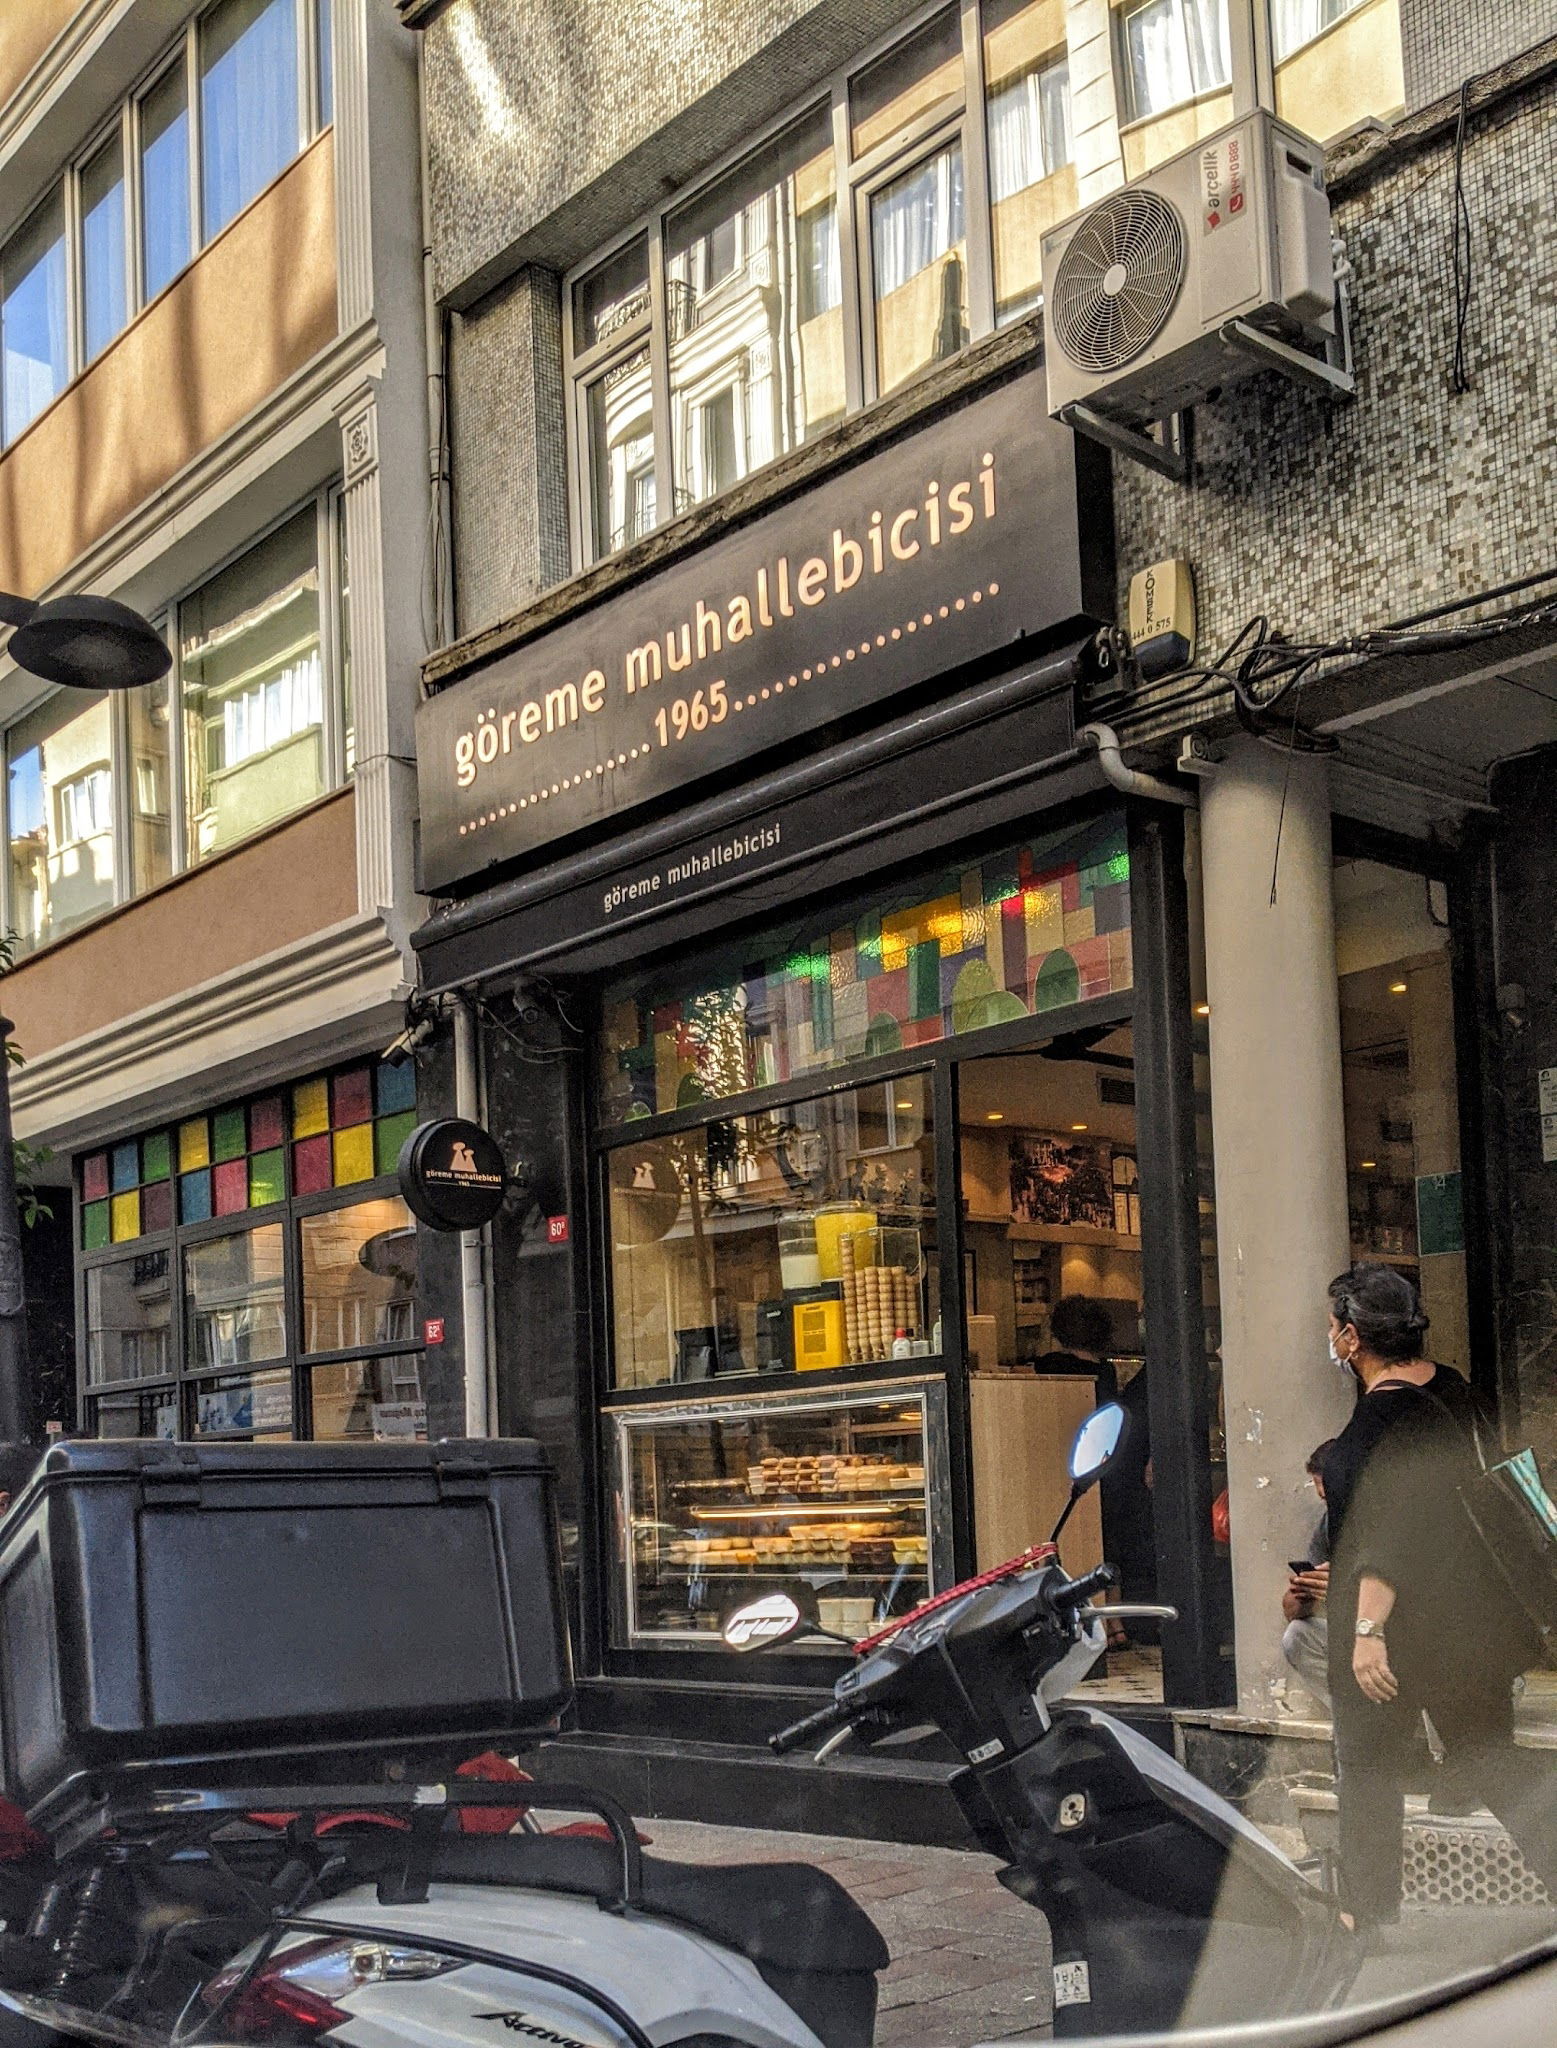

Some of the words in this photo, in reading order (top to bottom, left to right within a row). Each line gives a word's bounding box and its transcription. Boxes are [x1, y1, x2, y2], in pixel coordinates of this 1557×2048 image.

[1203, 151, 1221, 208] arçelik
[454, 668, 606, 787] göreme
[625, 452, 997, 695] muhallebicisi
[1155, 616, 1171, 631] 575
[655, 679, 729, 747] 1965
[603, 874, 661, 914] göreme
[667, 822, 782, 885] muhallebicisi
[425, 1169, 453, 1179] göreme
[454, 1172, 502, 1183] muhallebicisi
